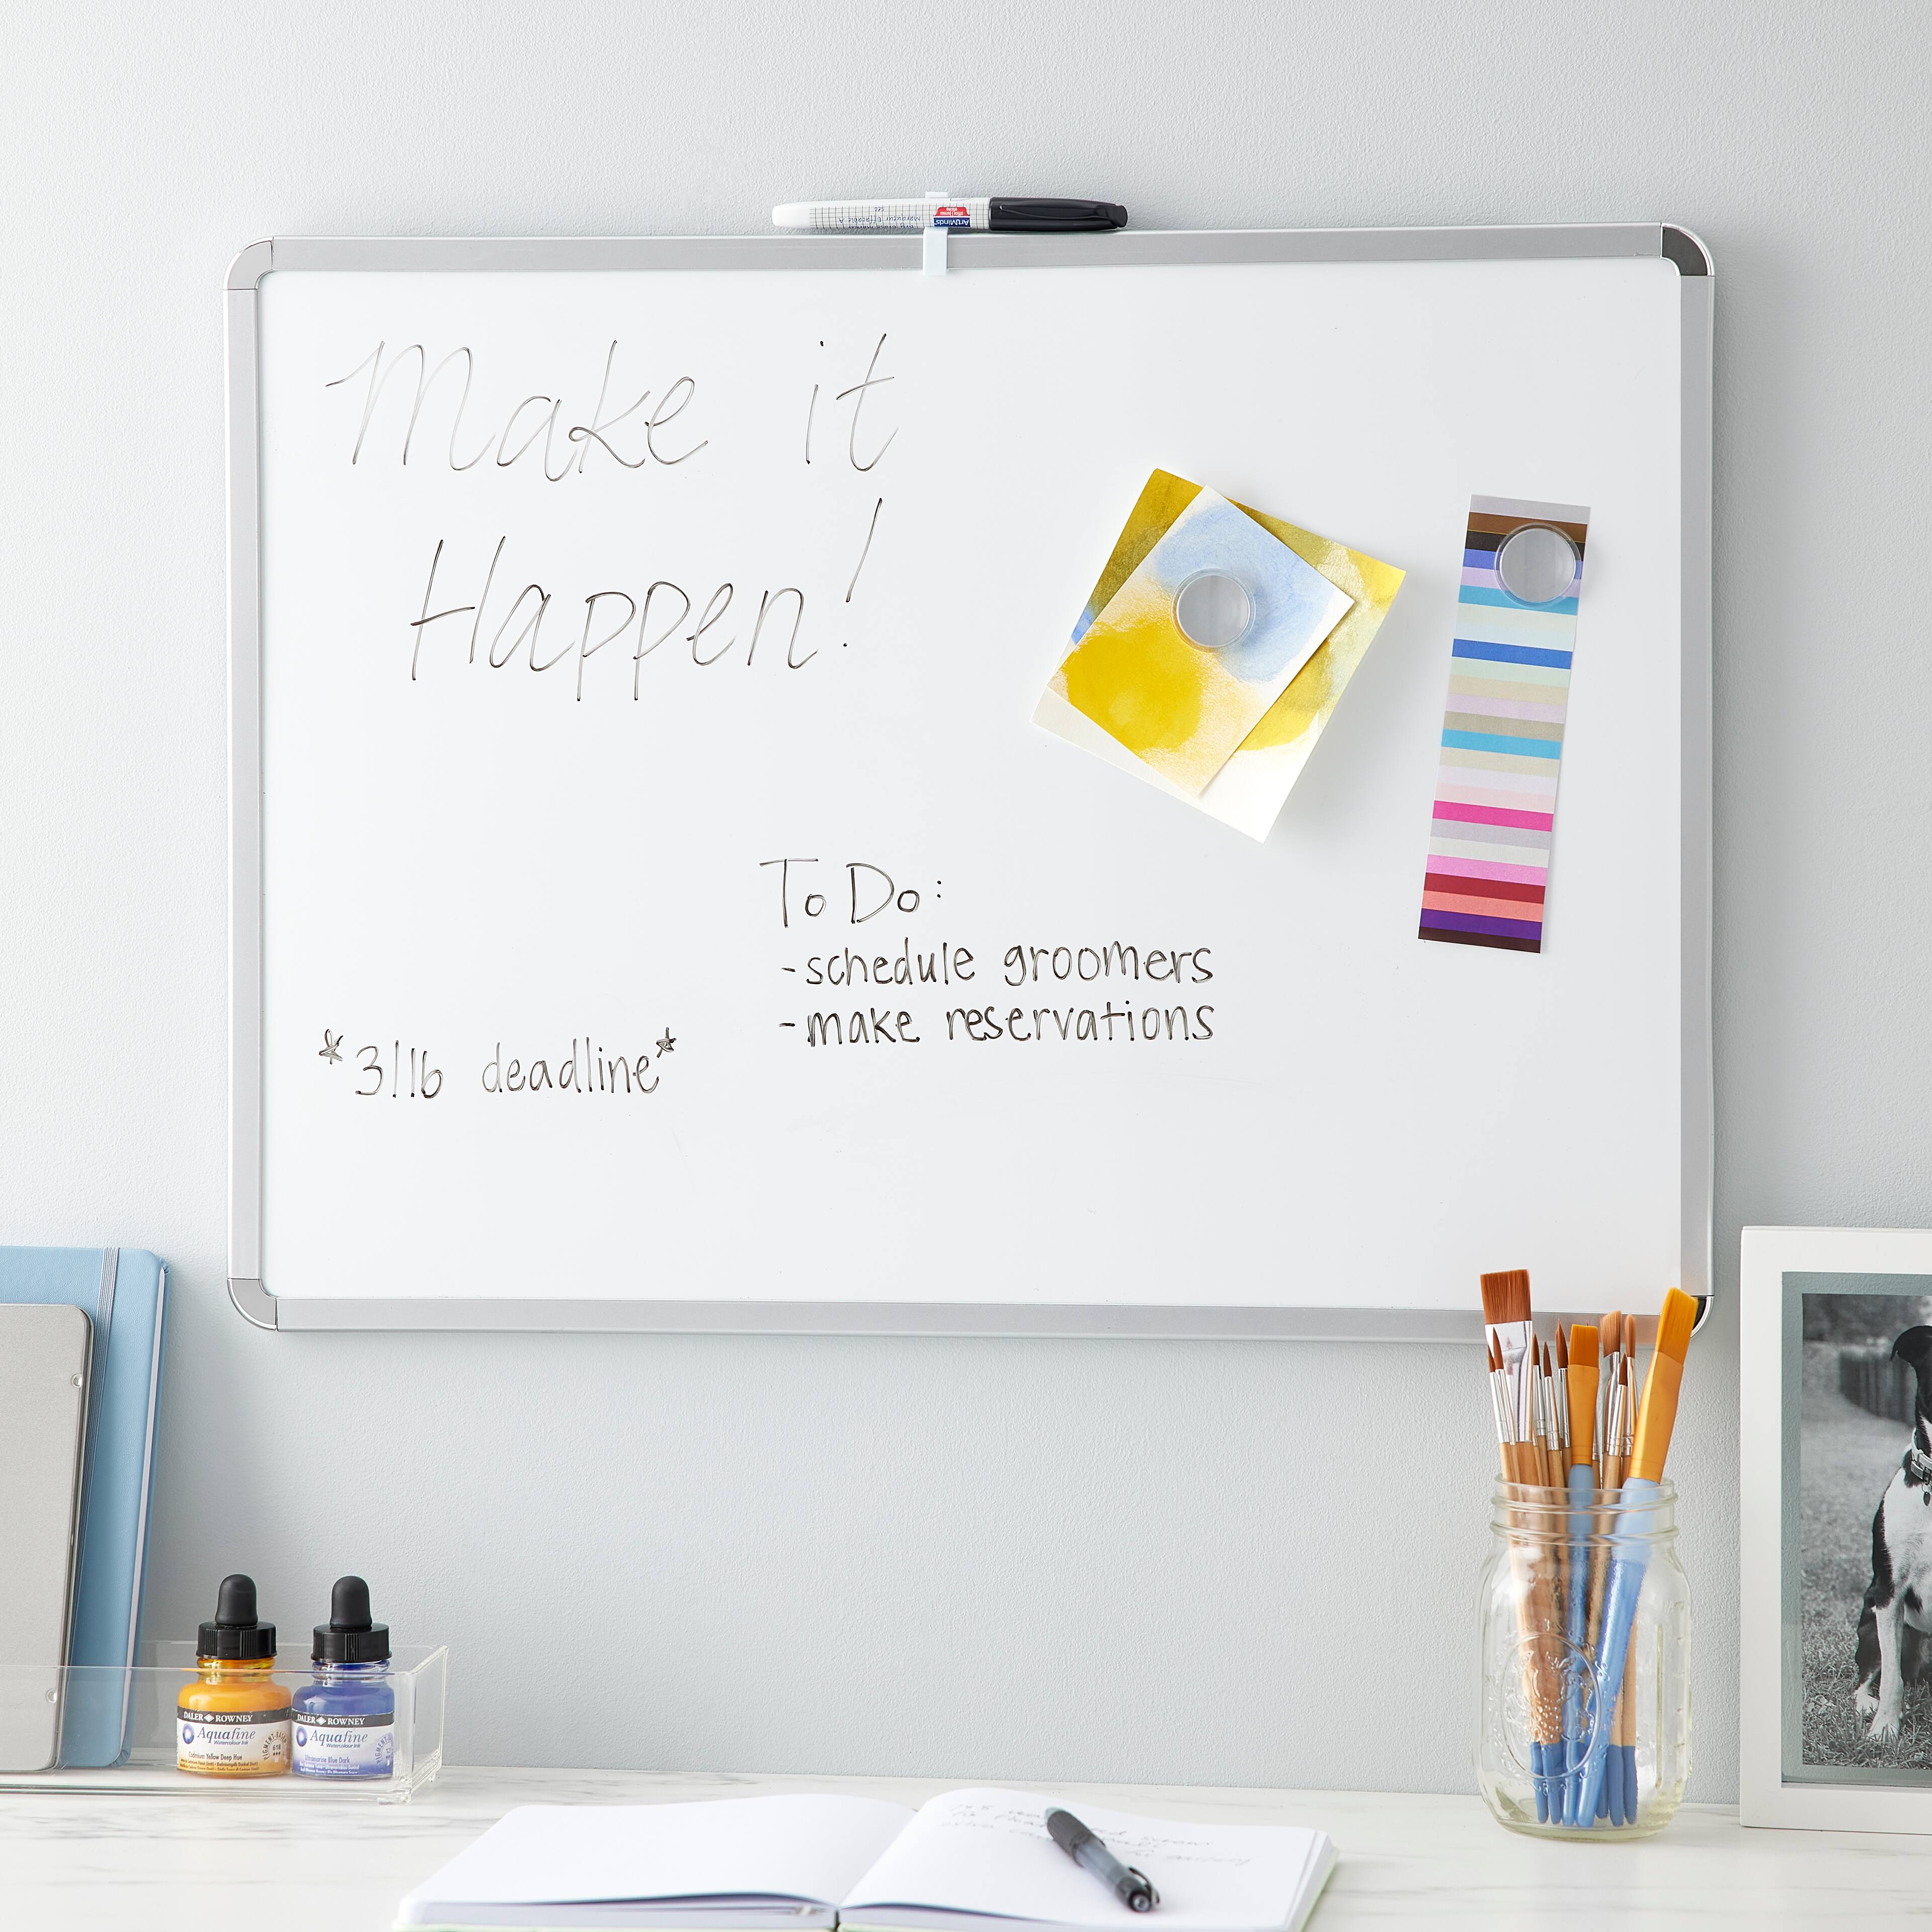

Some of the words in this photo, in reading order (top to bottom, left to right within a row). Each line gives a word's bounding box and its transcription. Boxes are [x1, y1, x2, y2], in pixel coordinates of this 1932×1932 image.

[935, 218, 970, 226] ArtMinds
[325, 340, 709, 482] Make
[804, 333, 899, 472] it
[410, 497, 883, 702] Happen!
[759, 858, 827, 928] To
[846, 862, 942, 924] Do:
[1004, 940, 1214, 986] groomers
[946, 1000, 1215, 1041] reservations
[184, 1711, 204, 1722] DALER
[215, 1714, 254, 1722] ROWNEY
[297, 1714, 316, 1724] DALER
[327, 1717, 365, 1725] ROWNEY
[197, 1727, 256, 1743] Aquafine
[310, 1730, 368, 1746] Aquafine
[189, 1751, 205, 1759] Cadmium
[220, 1754, 232, 1762] Deep
[305, 1754, 327, 1763] Ultramarine
